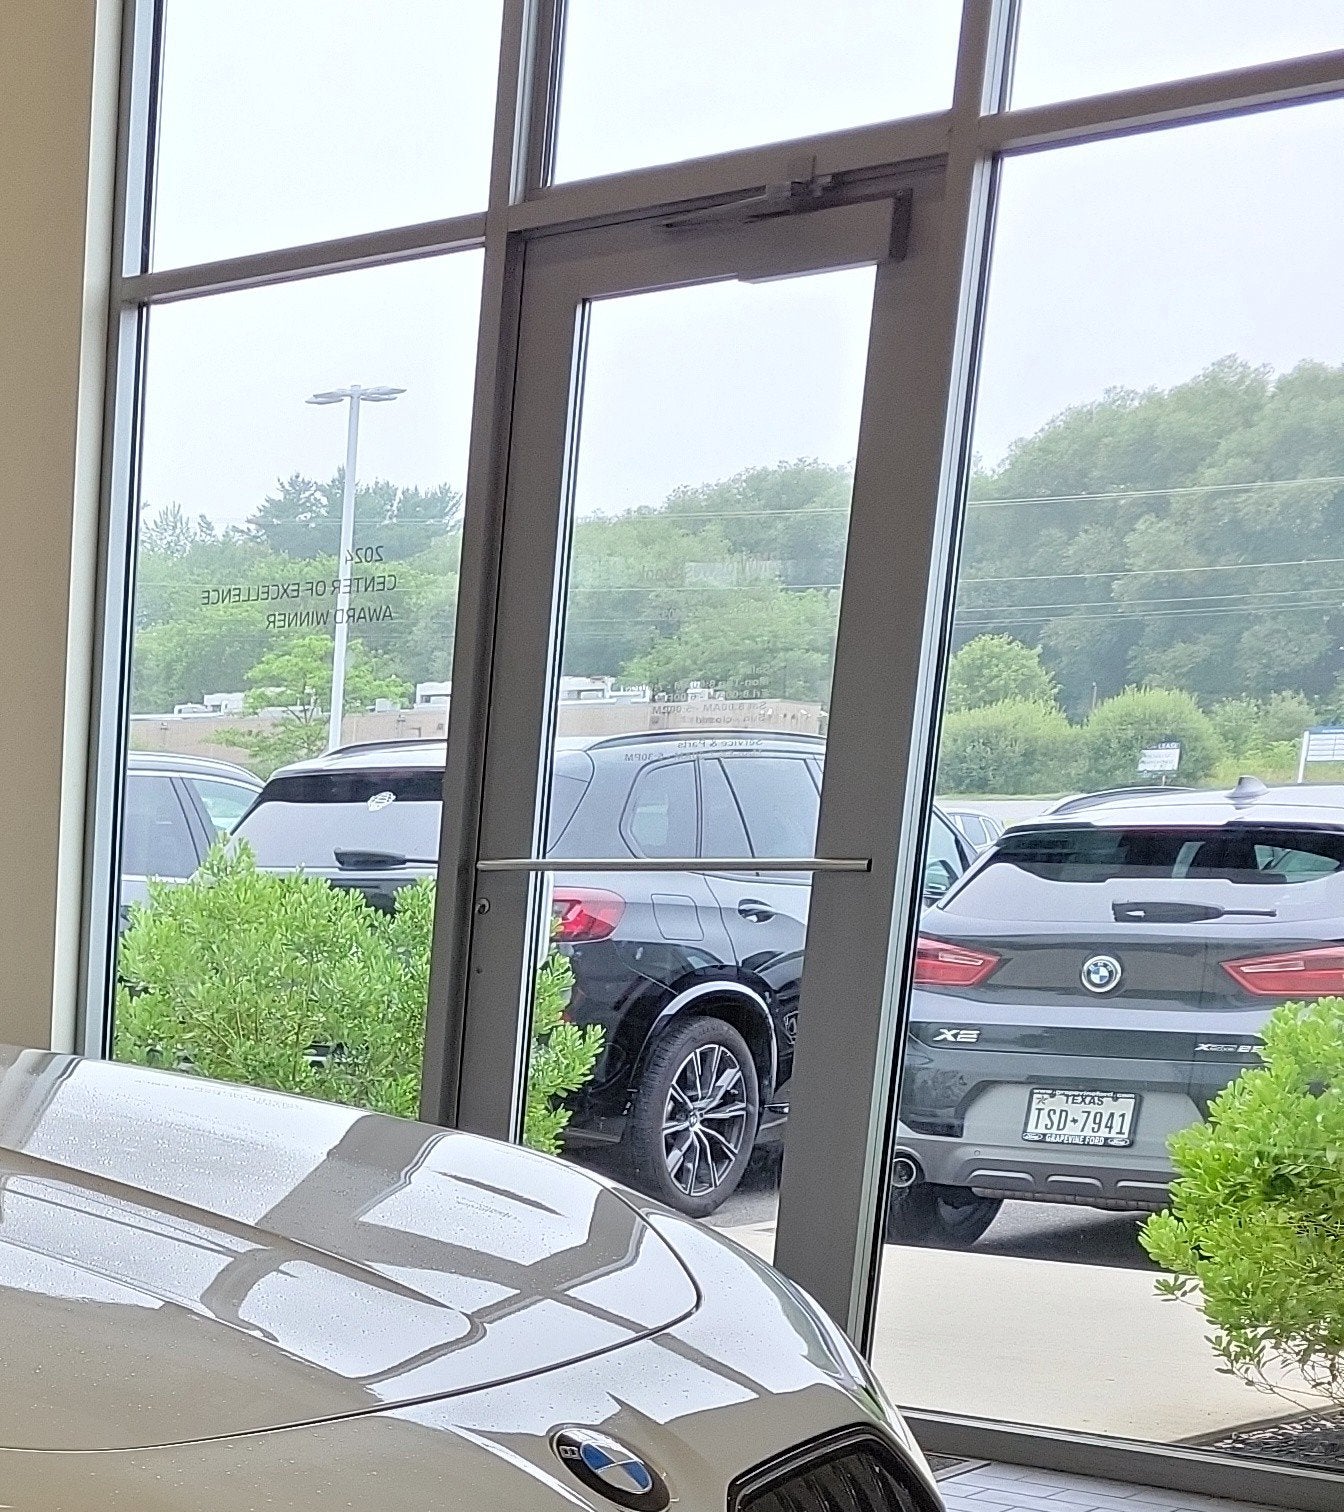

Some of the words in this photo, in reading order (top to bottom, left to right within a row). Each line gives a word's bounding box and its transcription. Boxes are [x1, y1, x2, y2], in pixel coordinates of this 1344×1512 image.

[1064, 1093, 1104, 1107] TEXAS
[1045, 1133, 1085, 1145] GRAPEVINE
[1084, 1136, 1105, 1146] FORD
